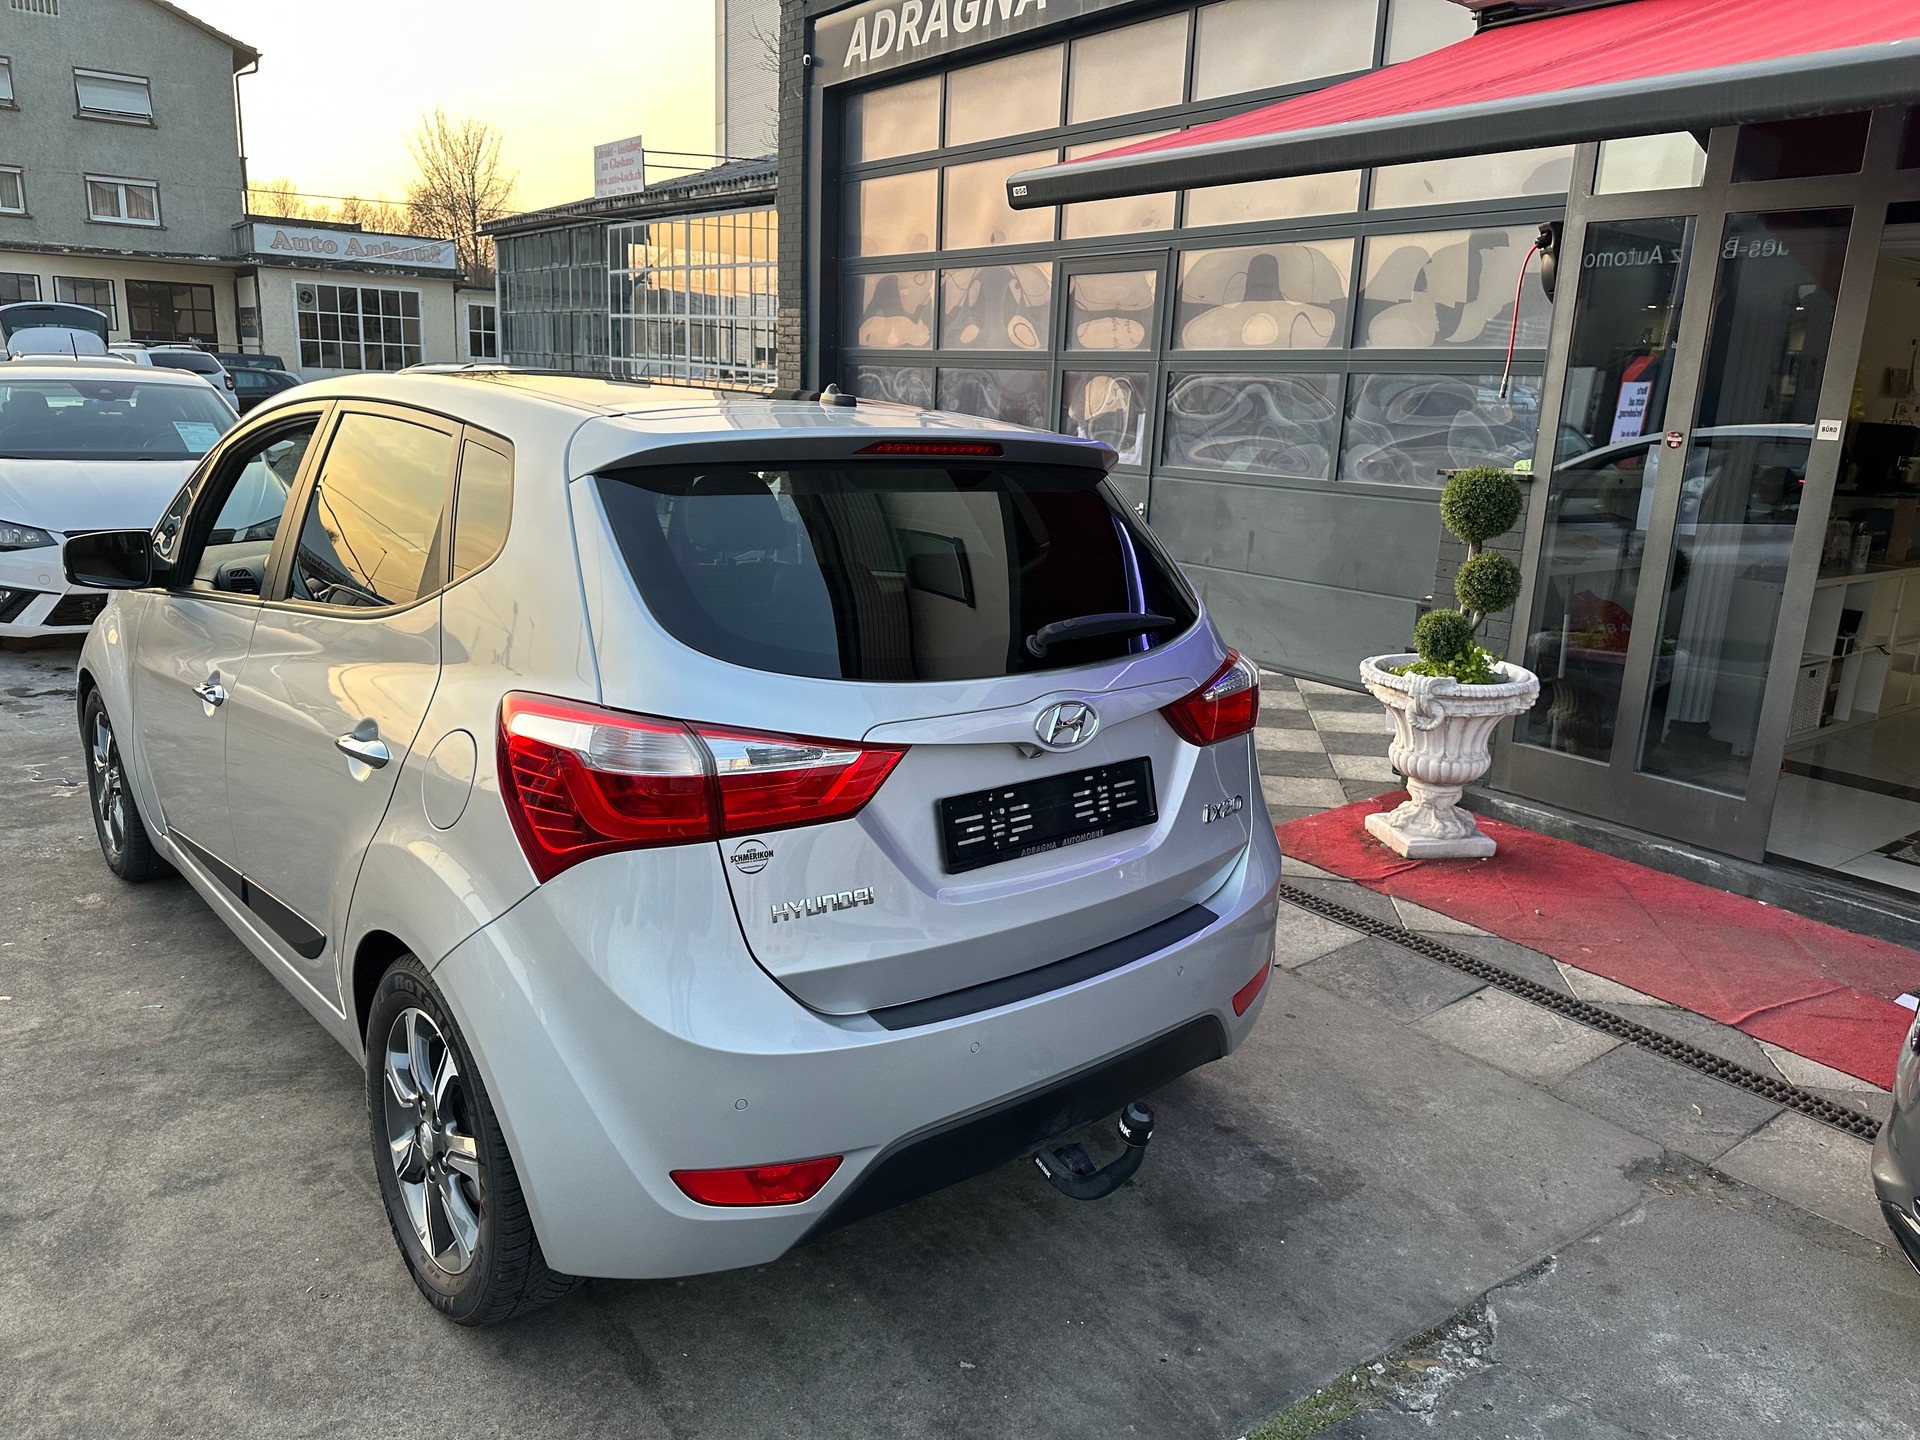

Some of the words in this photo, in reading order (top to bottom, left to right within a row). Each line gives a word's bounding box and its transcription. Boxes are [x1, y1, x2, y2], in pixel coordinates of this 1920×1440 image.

[610, 156, 634, 169] Glashaus
[270, 230, 338, 254] Auto
[344, 237, 441, 263] Ankauf
[1821, 425, 1838, 433] BÜRO
[1021, 841, 1057, 857] ADRAGNA
[1062, 829, 1104, 847] AUTOMOBILE
[730, 850, 774, 863] SCHMERIKON
[770, 886, 875, 924] HYUNDAI
